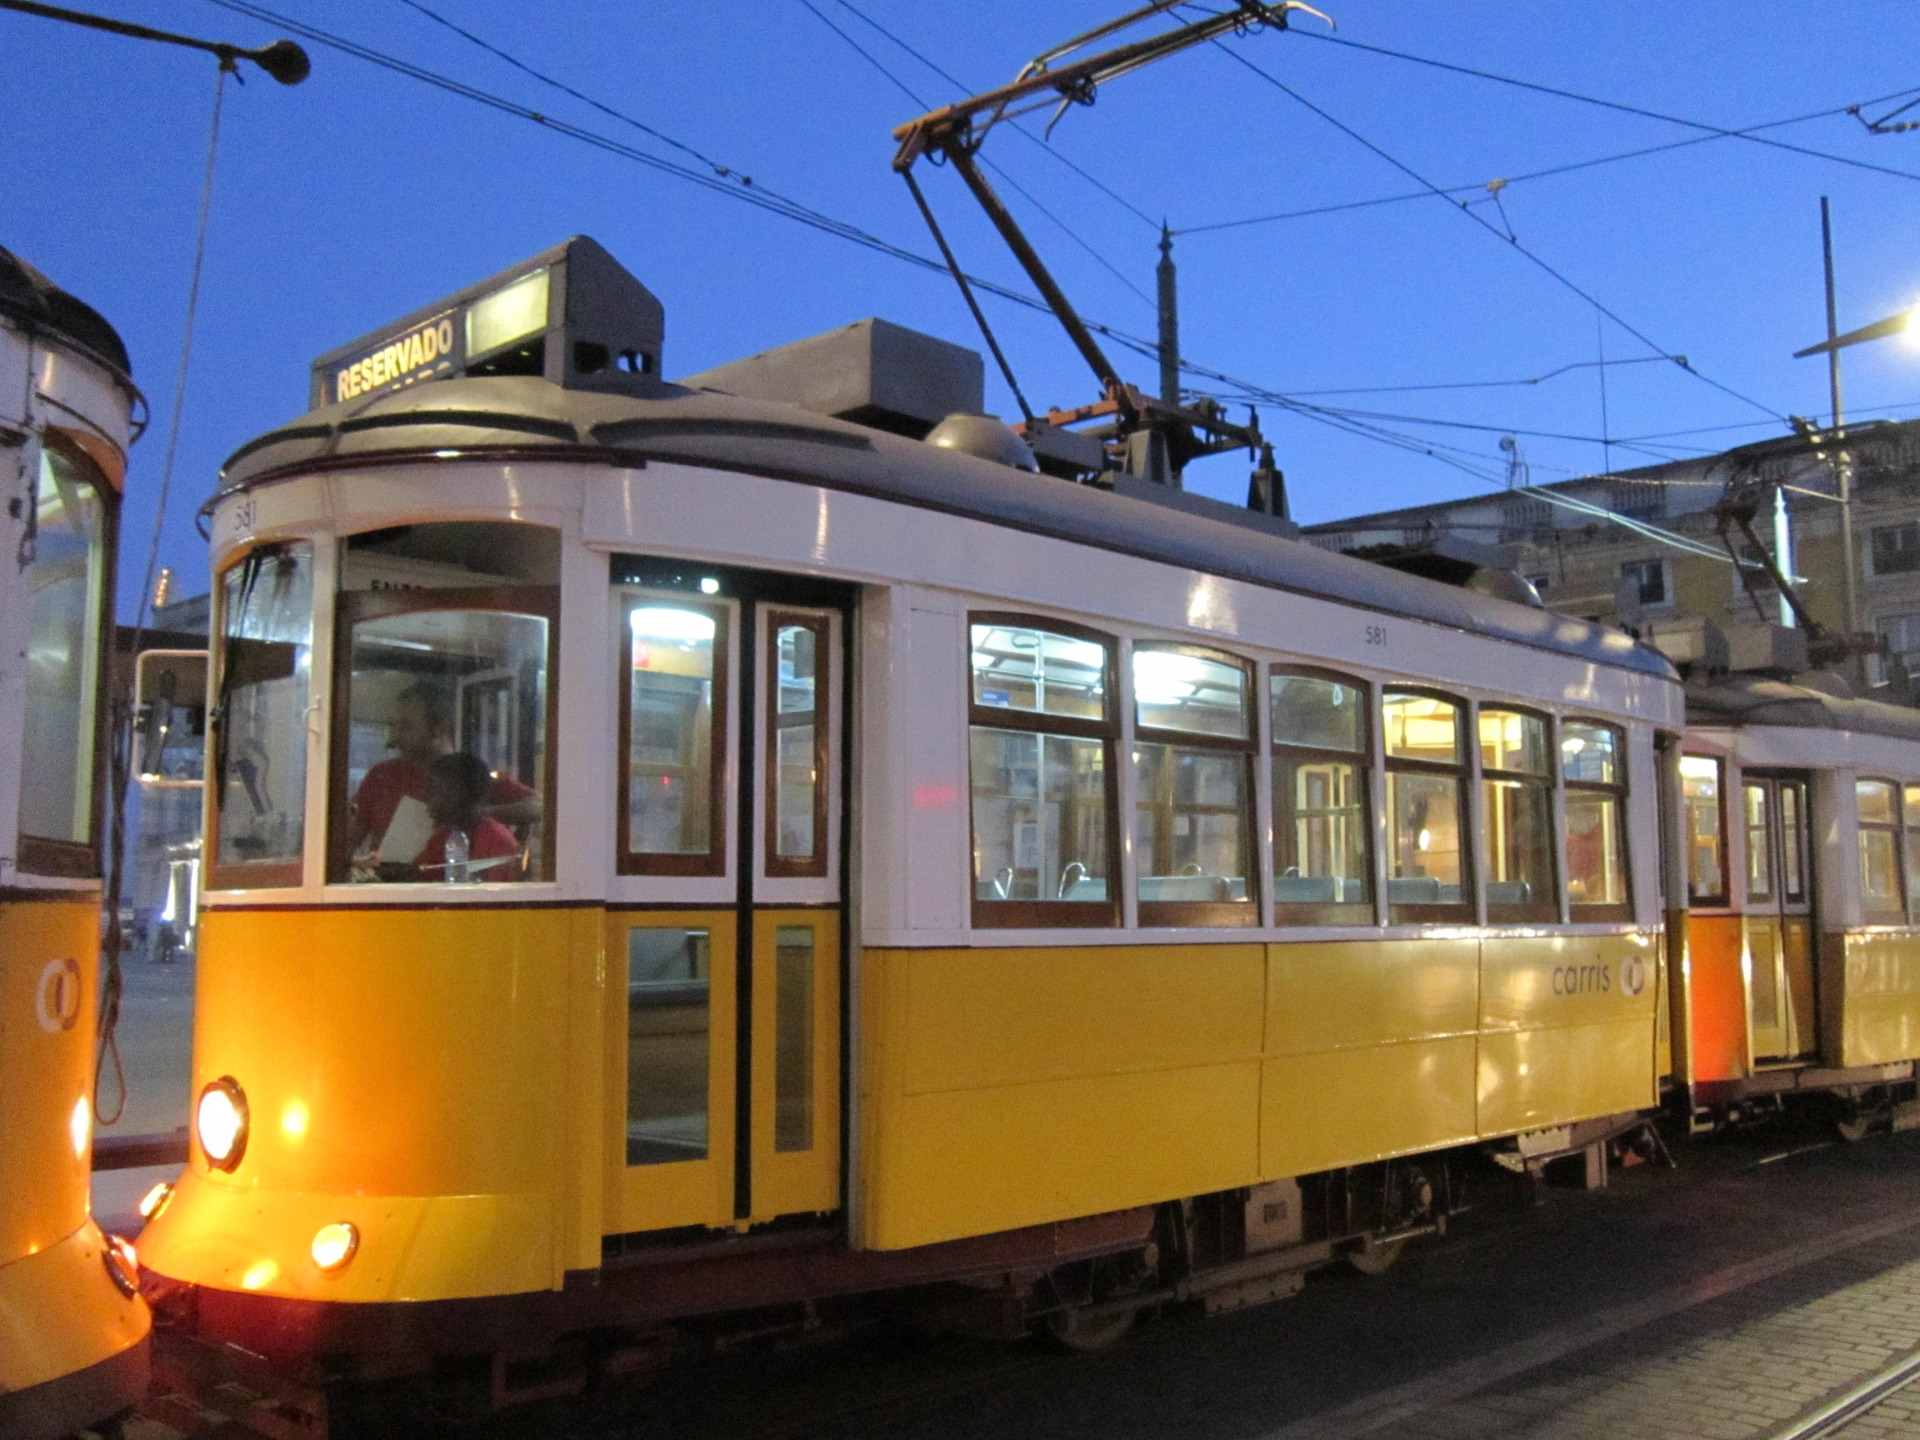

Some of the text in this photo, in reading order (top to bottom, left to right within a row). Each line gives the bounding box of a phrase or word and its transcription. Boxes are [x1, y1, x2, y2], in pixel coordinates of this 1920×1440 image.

[337, 319, 453, 402] RESERVADO
[235, 500, 256, 531] 581
[1366, 626, 1387, 647] 581
[1552, 954, 1610, 995] carris
